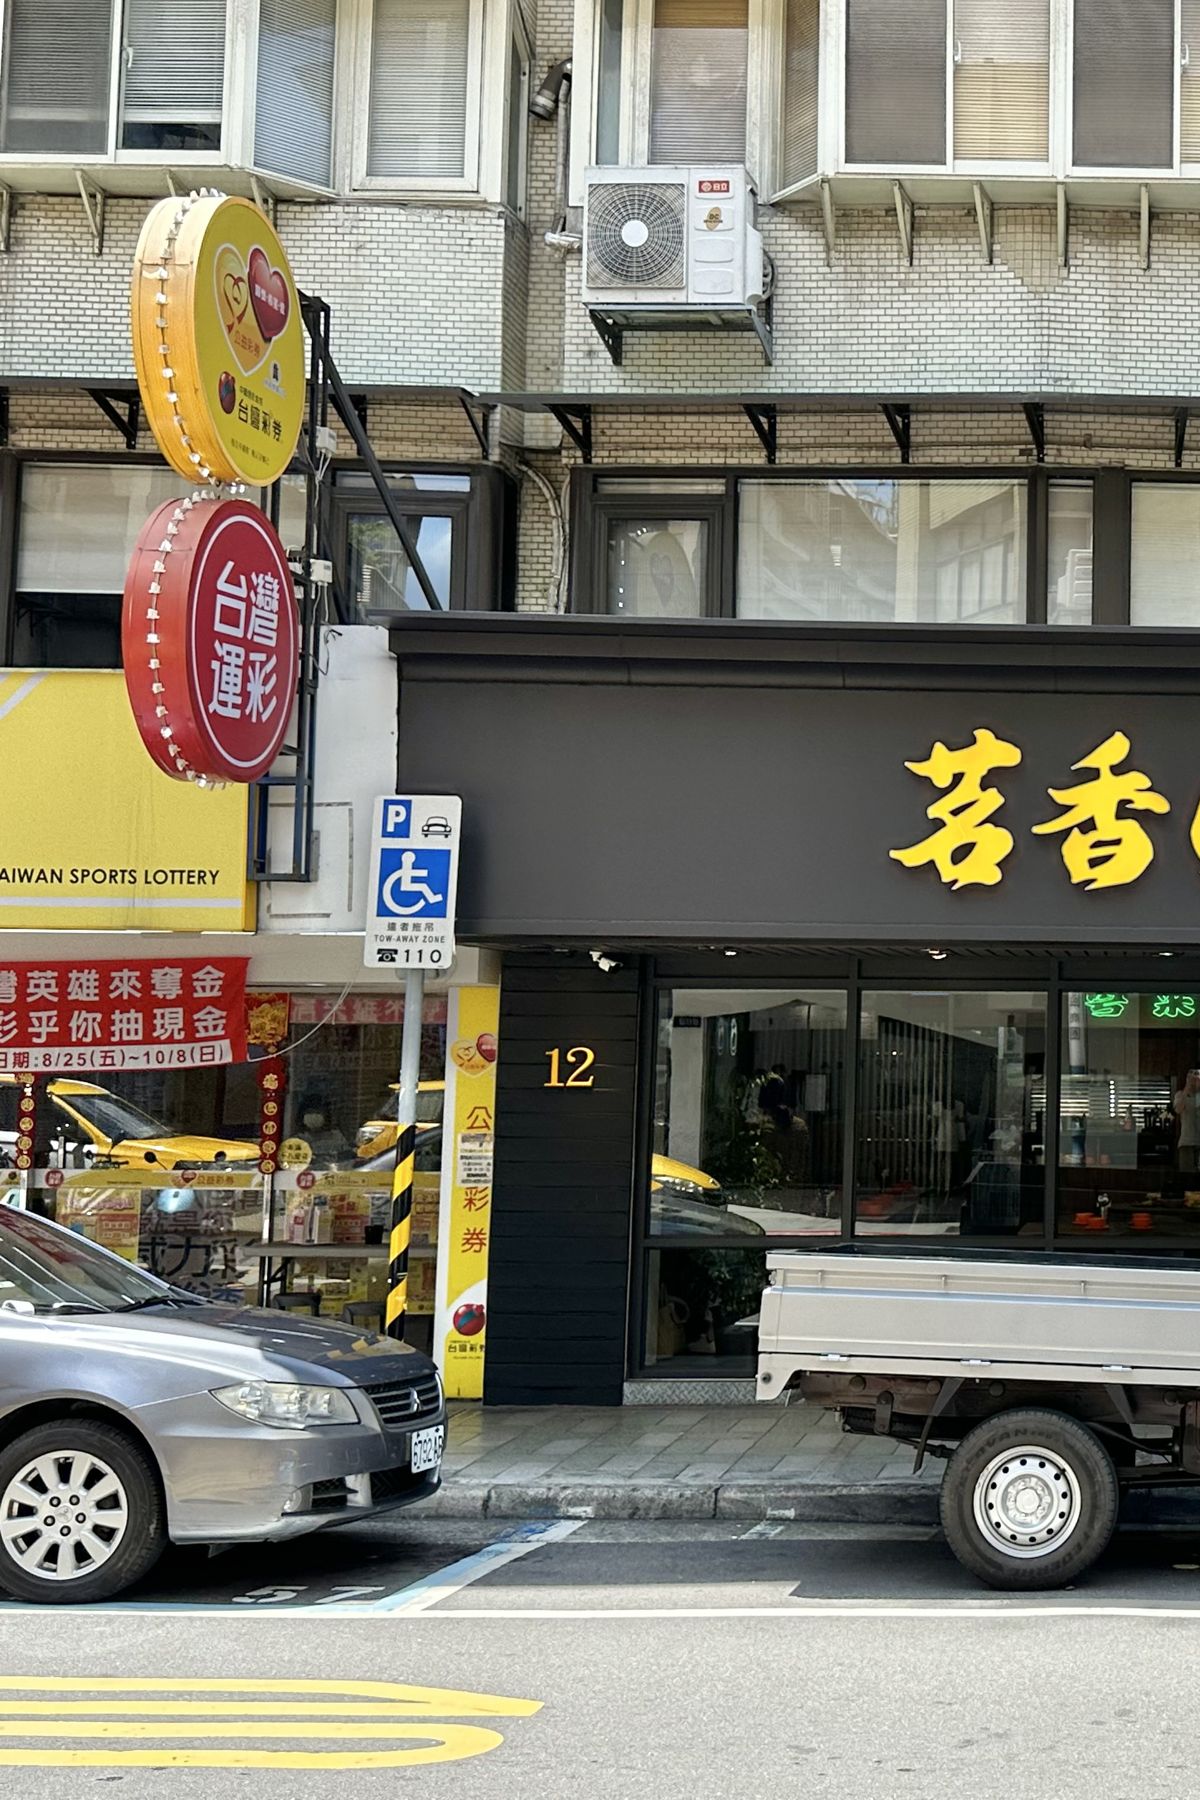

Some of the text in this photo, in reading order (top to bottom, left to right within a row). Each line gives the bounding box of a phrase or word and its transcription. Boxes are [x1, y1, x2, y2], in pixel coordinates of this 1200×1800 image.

[386, 804, 407, 833] P
[69, 869, 137, 884] SPORTS
[144, 869, 220, 885] LOTTERY
[387, 922, 434, 932] 違者拖吊
[374, 934, 446, 944] TOW-AWAY ZONE
[404, 949, 442, 964] 110
[544, 1047, 594, 1087] 12
[461, 1106, 492, 1253] 公彩券
